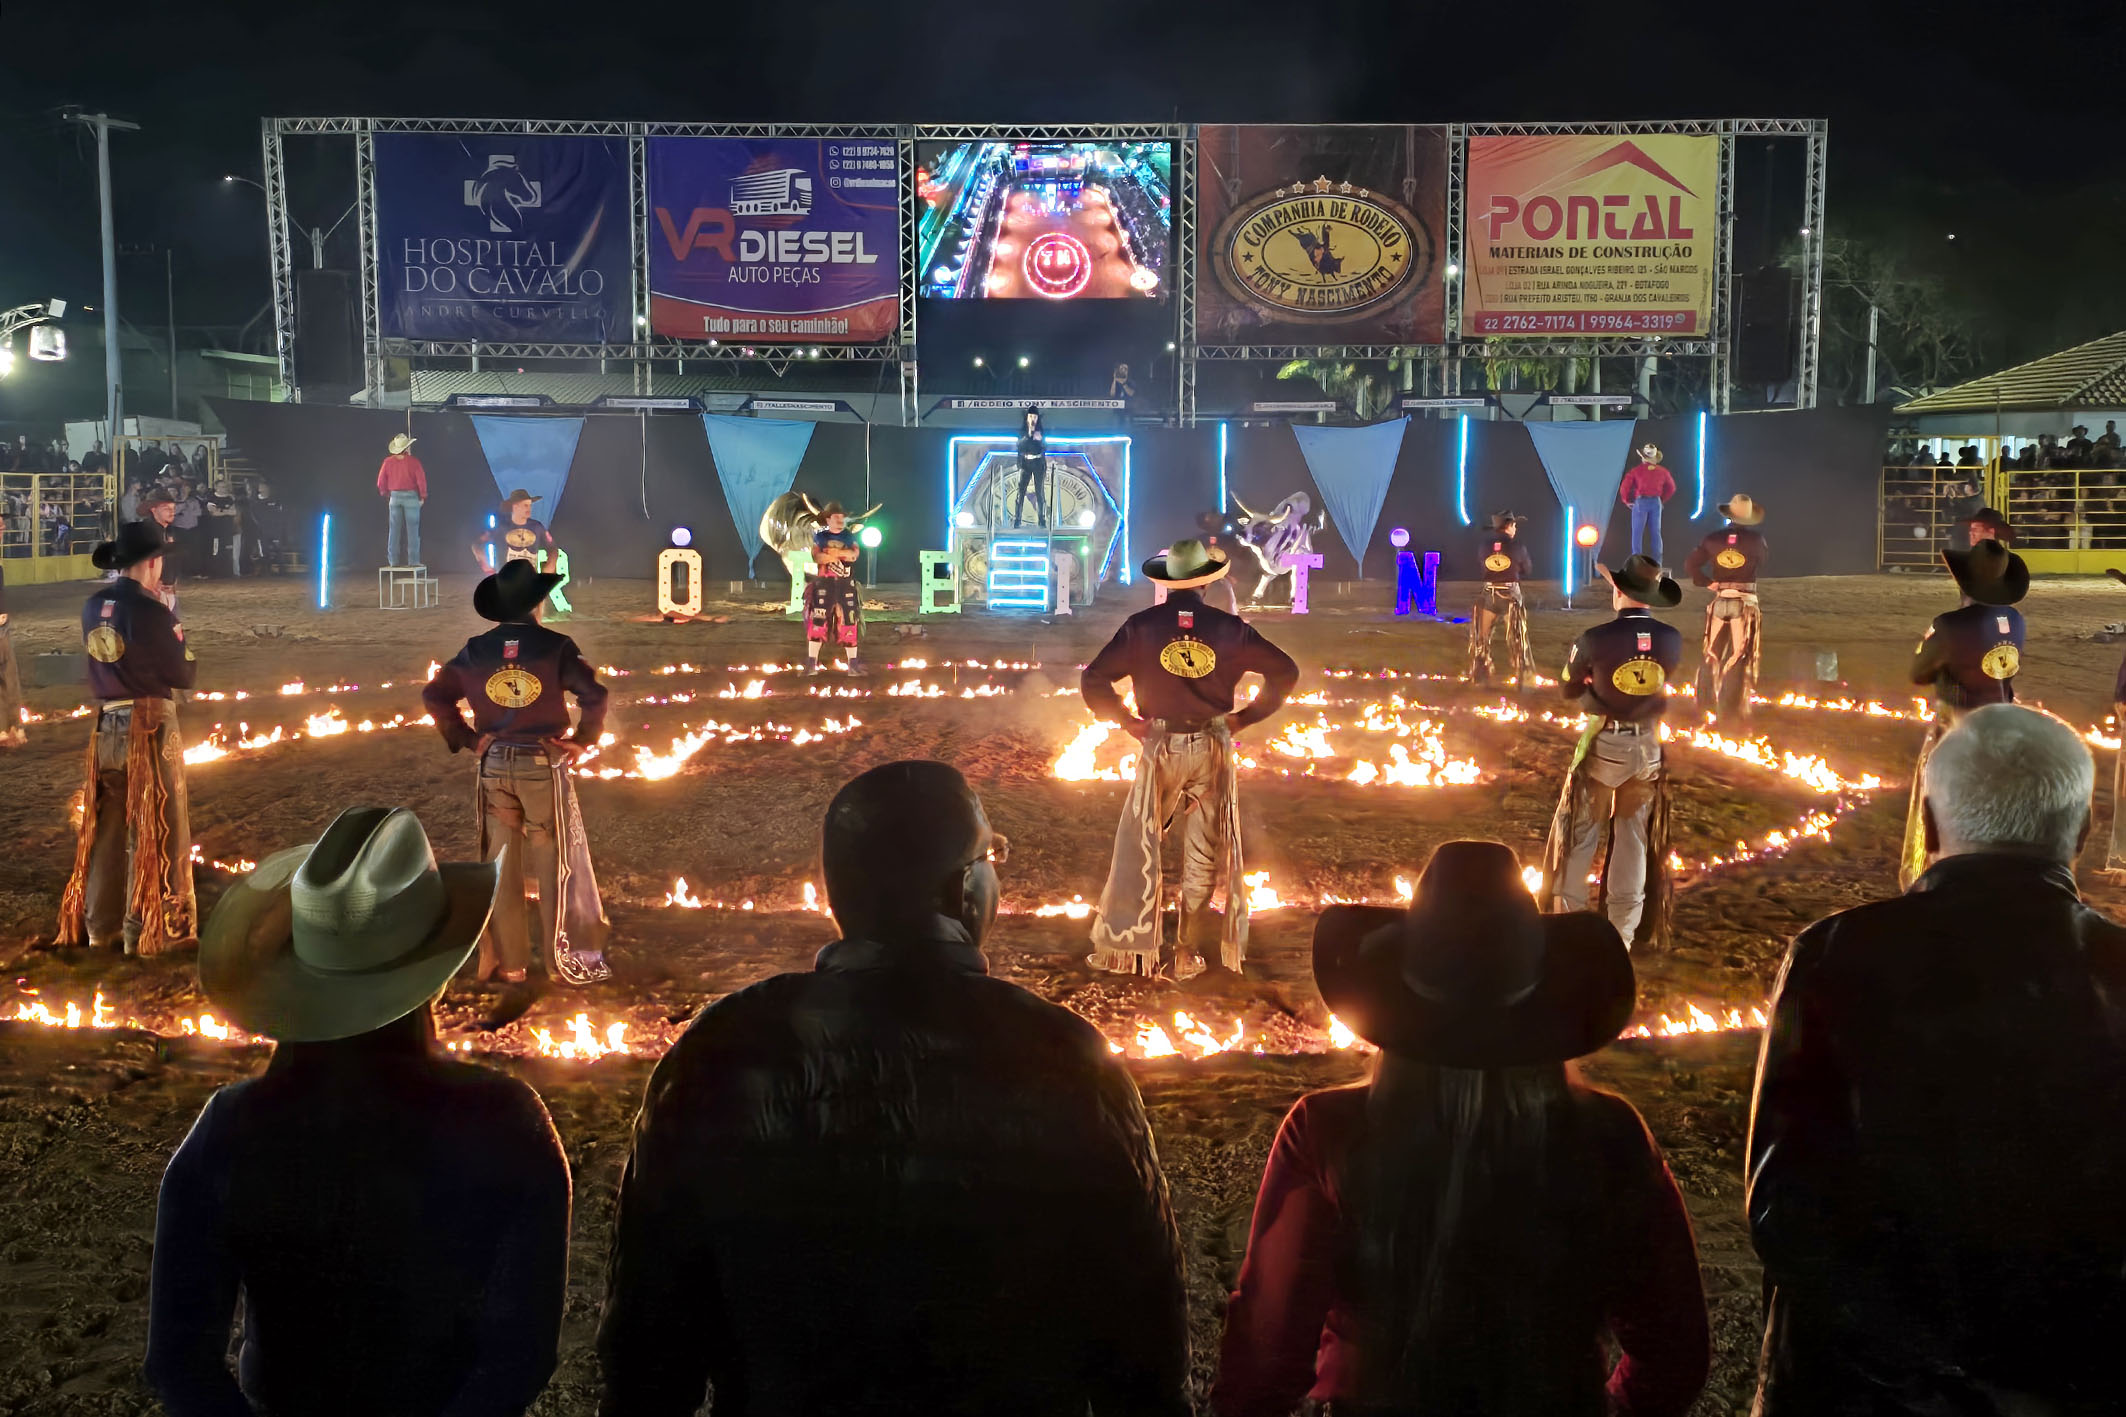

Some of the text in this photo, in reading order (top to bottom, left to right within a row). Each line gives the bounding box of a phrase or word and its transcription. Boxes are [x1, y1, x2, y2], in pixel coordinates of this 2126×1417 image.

[1243, 200, 1402, 248] COMPANHIA DE RODEIO
[1489, 195, 1694, 240] PONTAL
[654, 208, 879, 264] VR DIESEL
[404, 238, 565, 267] HOSPITAL
[1489, 243, 1694, 260] MATERIAIS DE CONSTRUÇÃO
[728, 266, 821, 288] AUTO PEÇAS
[1508, 265, 1539, 275] ESTRADA
[1540, 265, 1564, 275] ISRAEL
[1565, 265, 1606, 276] GONÇALVES
[1654, 263, 1668, 274] SÃO
[1669, 265, 1698, 274] MARCOS
[404, 266, 604, 296] DO CAVALO
[1246, 265, 1395, 306] TONY NASCIMENTO
[1536, 281, 1550, 290] RUA
[1635, 280, 1670, 289] BOTAFOGO
[1504, 294, 1517, 303] RUA
[1519, 294, 1551, 303] PREFEITO
[1604, 294, 1631, 303] GRANJA
[1633, 294, 1647, 303] DOS
[703, 316, 849, 335] Tudo para o seu caminhão!
[1485, 319, 1498, 330] 22
[1503, 315, 1576, 330] 2762-7174
[1590, 315, 1674, 329] 99964-3319
[1018, 400, 1047, 408] TONY
[1051, 400, 1119, 408] NASCIMENTO
